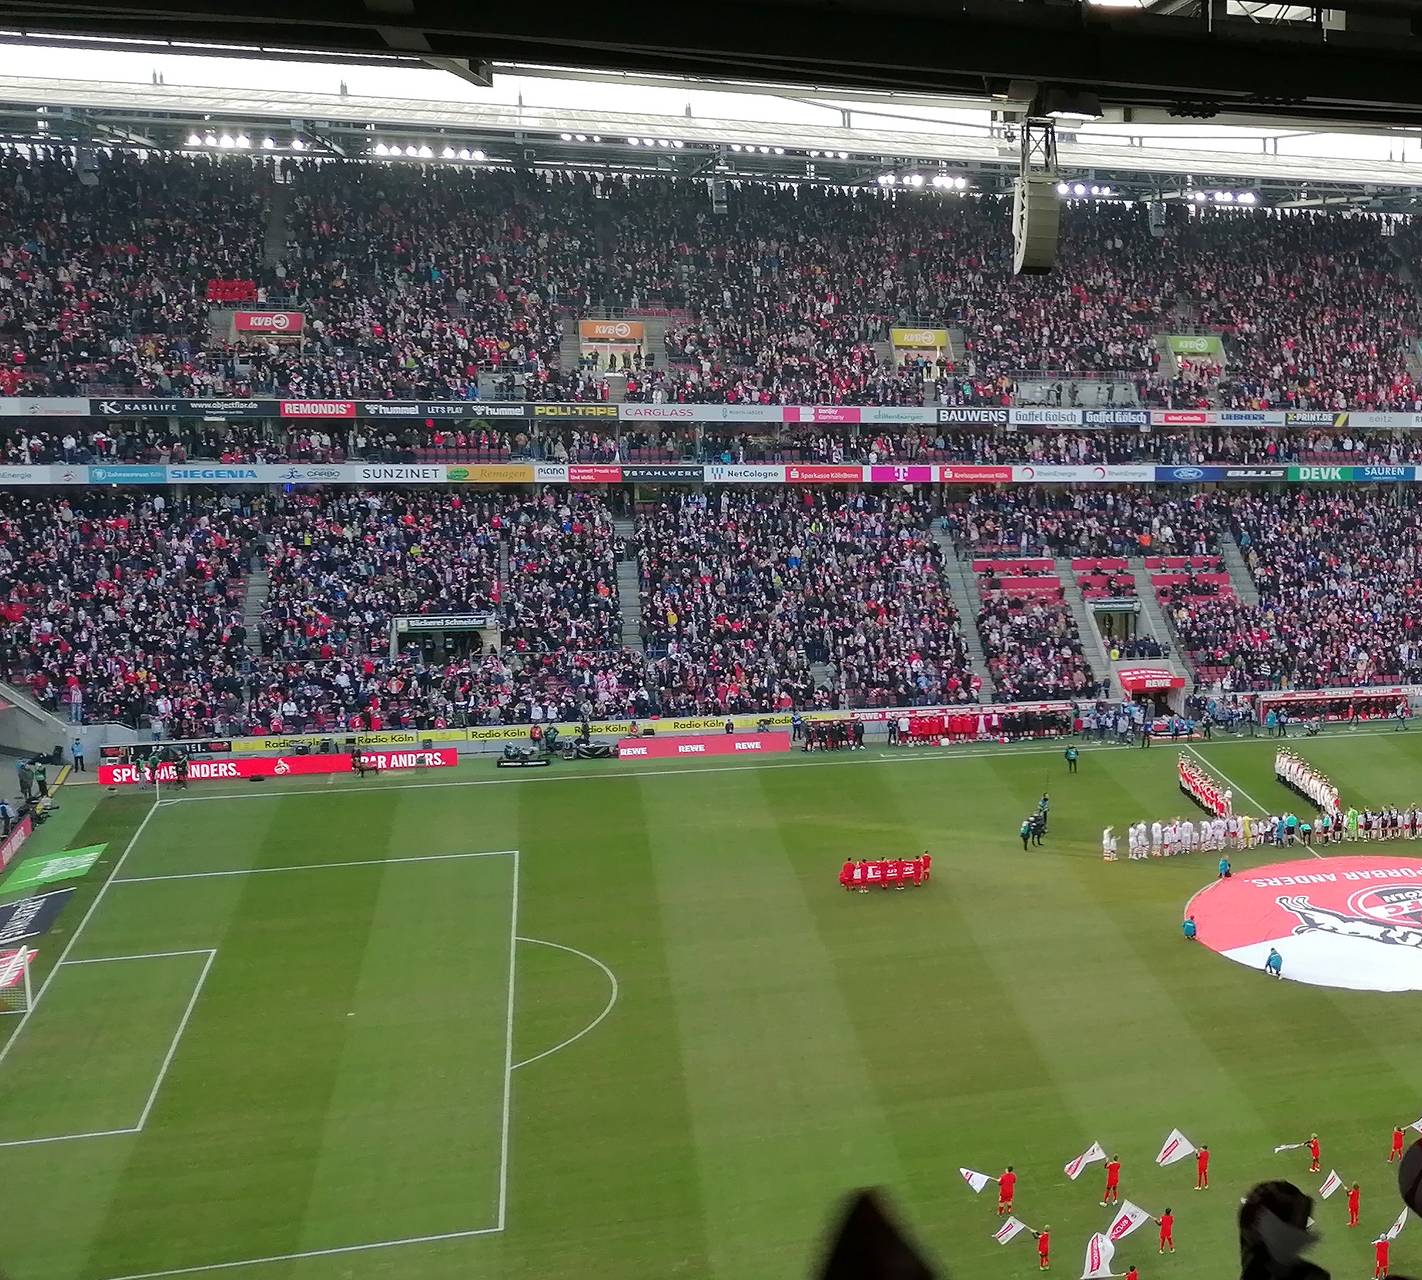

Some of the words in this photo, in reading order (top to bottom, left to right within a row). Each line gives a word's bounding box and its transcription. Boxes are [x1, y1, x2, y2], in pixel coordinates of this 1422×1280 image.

[285, 403, 347, 414] REMONDIS
[380, 405, 420, 414] hummel
[448, 406, 464, 414] PLAY
[486, 406, 525, 416] hummel
[535, 406, 618, 416] POLI-TAPE
[625, 409, 694, 417] CARGLASS
[939, 410, 1007, 422] BAUWENS
[170, 470, 258, 479] SIEGENIA
[362, 469, 440, 479] SUNZINET
[727, 470, 779, 479] NetCologne
[1299, 467, 1342, 480] DEVK
[1364, 466, 1405, 476] SAUREN
[1145, 679, 1172, 688] REWE
[604, 724, 628, 734] Köln
[673, 721, 701, 730] Radio
[702, 719, 724, 729] Köln
[357, 735, 387, 744] Radio
[389, 733, 414, 742] Köln
[471, 730, 500, 739] Radio
[502, 728, 526, 738] Köln
[619, 747, 648, 756] REWE
[678, 744, 705, 754] REWE
[735, 741, 761, 751] REWE
[1243, 872, 1337, 889] ANDERS.
